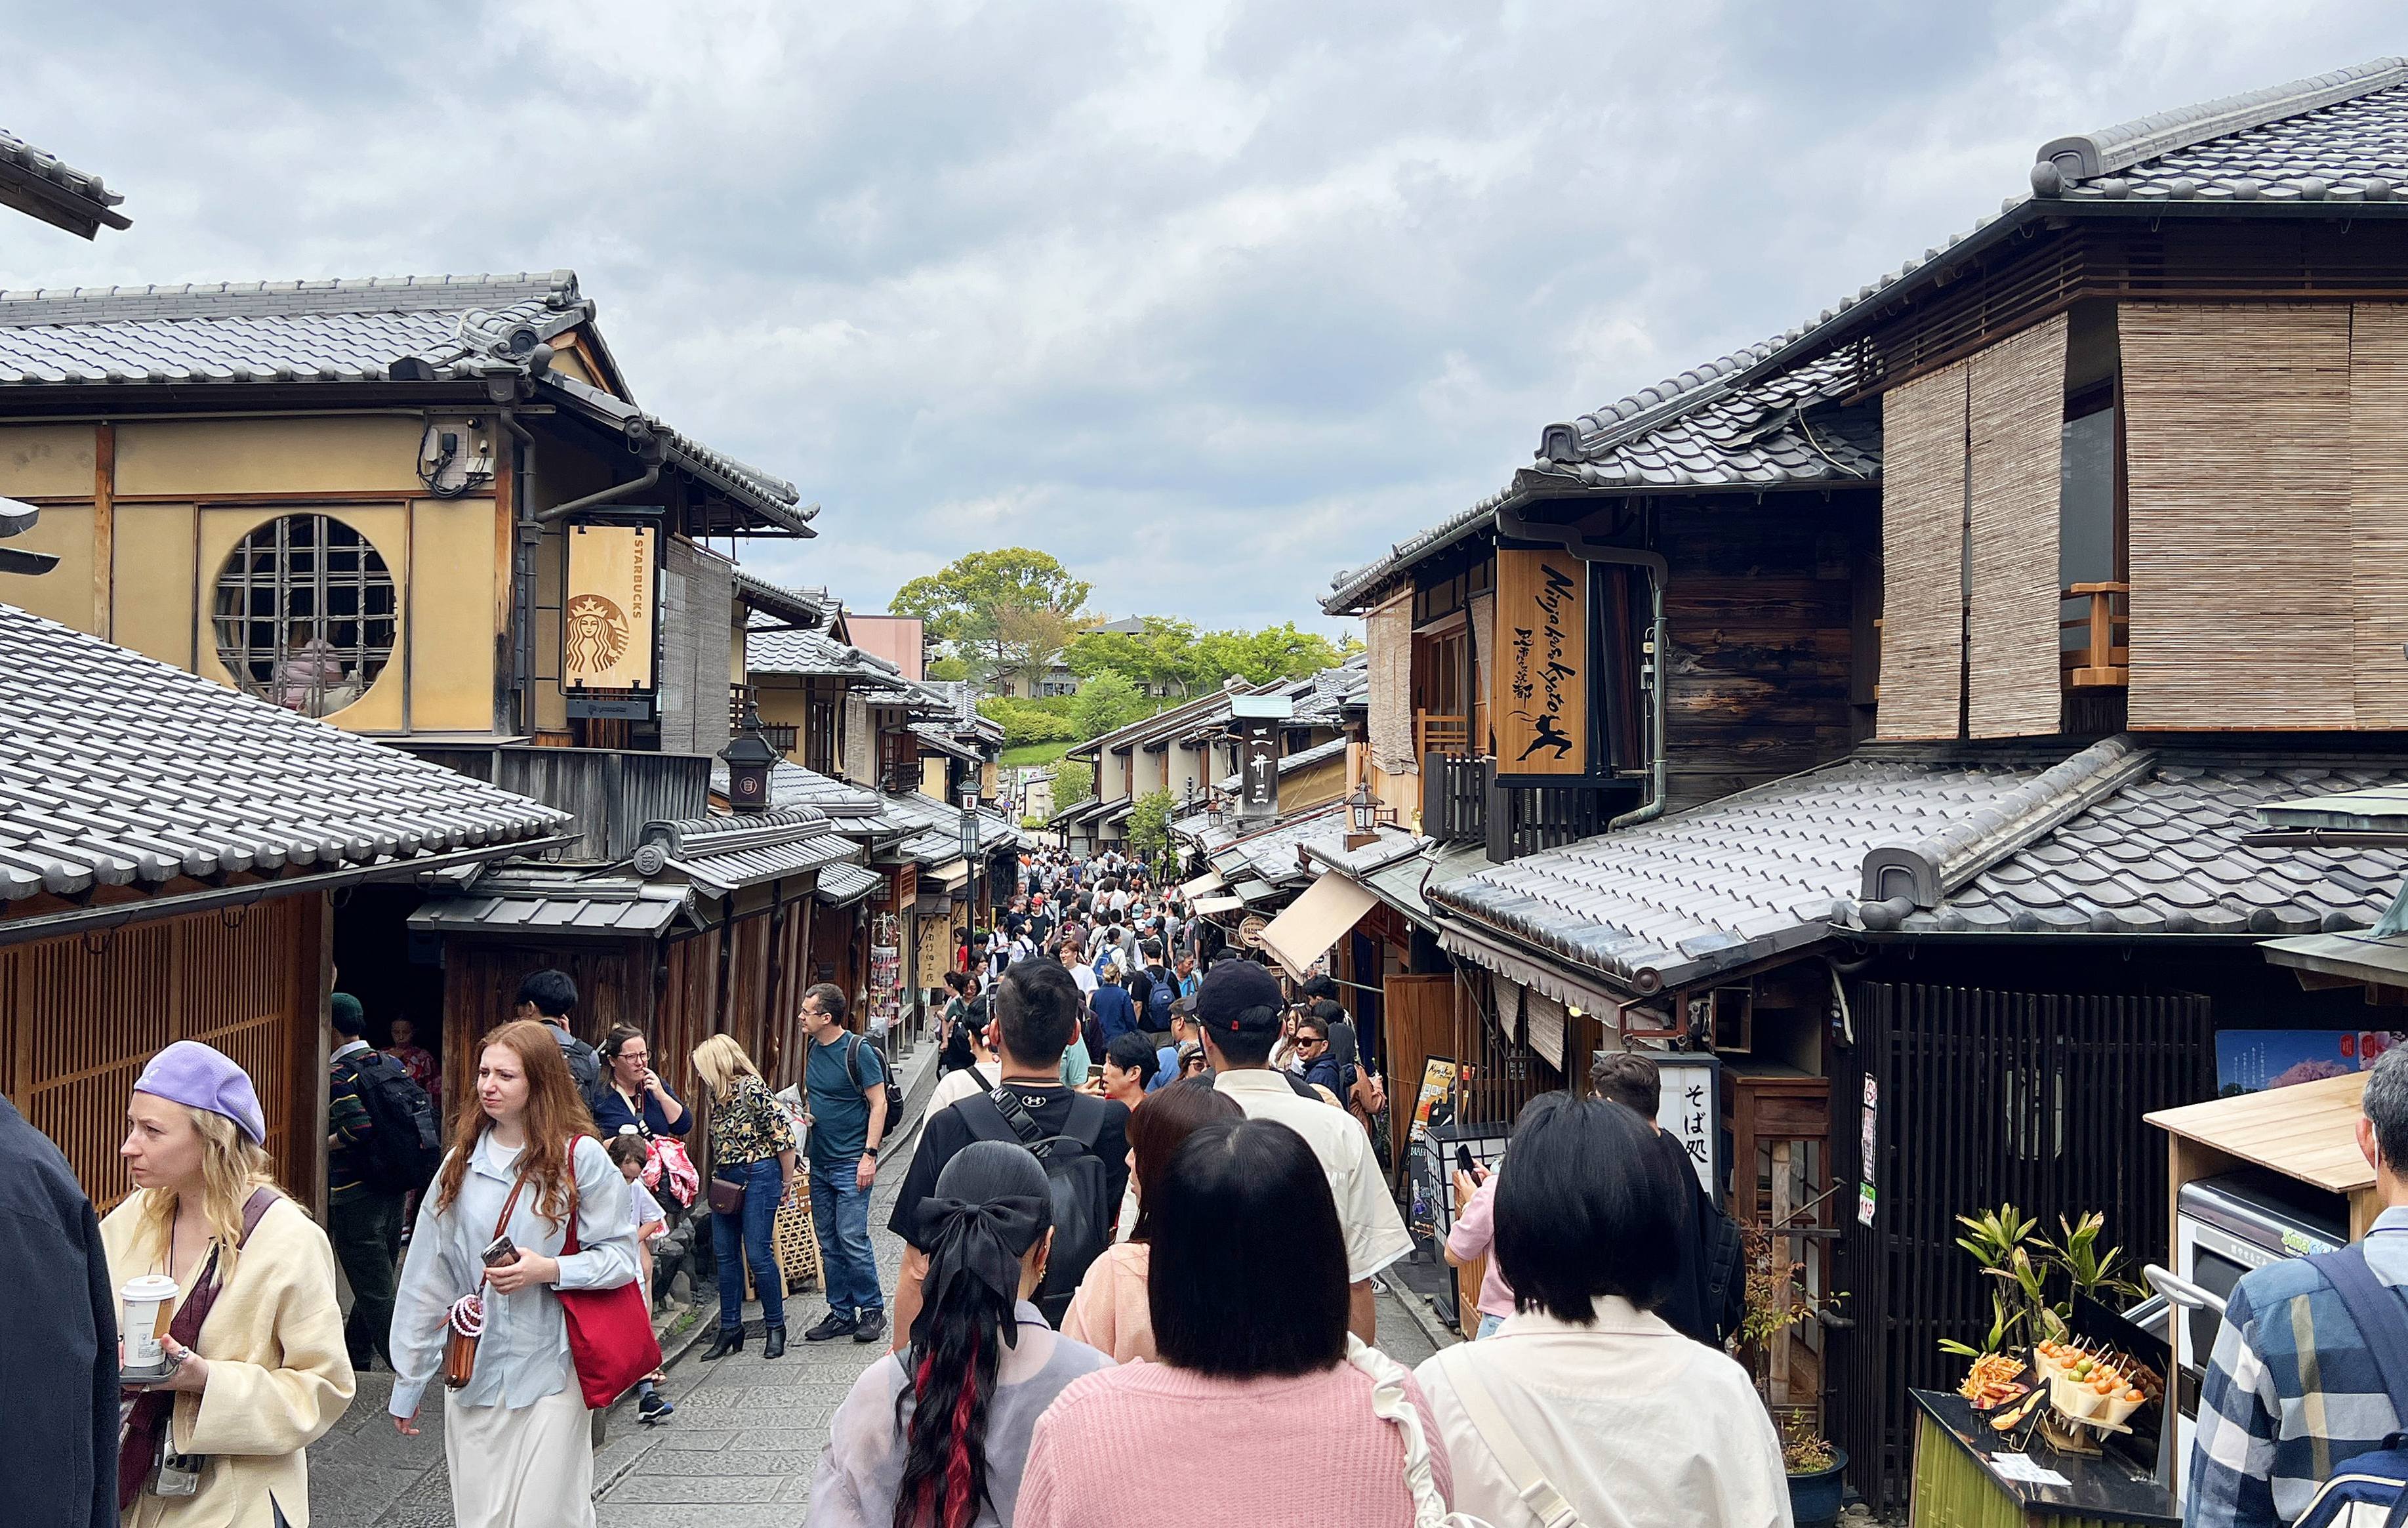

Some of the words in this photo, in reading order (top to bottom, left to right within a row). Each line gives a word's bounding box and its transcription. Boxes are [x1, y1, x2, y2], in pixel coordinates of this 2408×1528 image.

[633, 540, 643, 618] STARBUCKS
[1535, 564, 1574, 625] Ninja
[1537, 661, 1576, 712] Kyoto
[1684, 1084, 1708, 1163] そば処
[1861, 1201, 1872, 1219] 119
